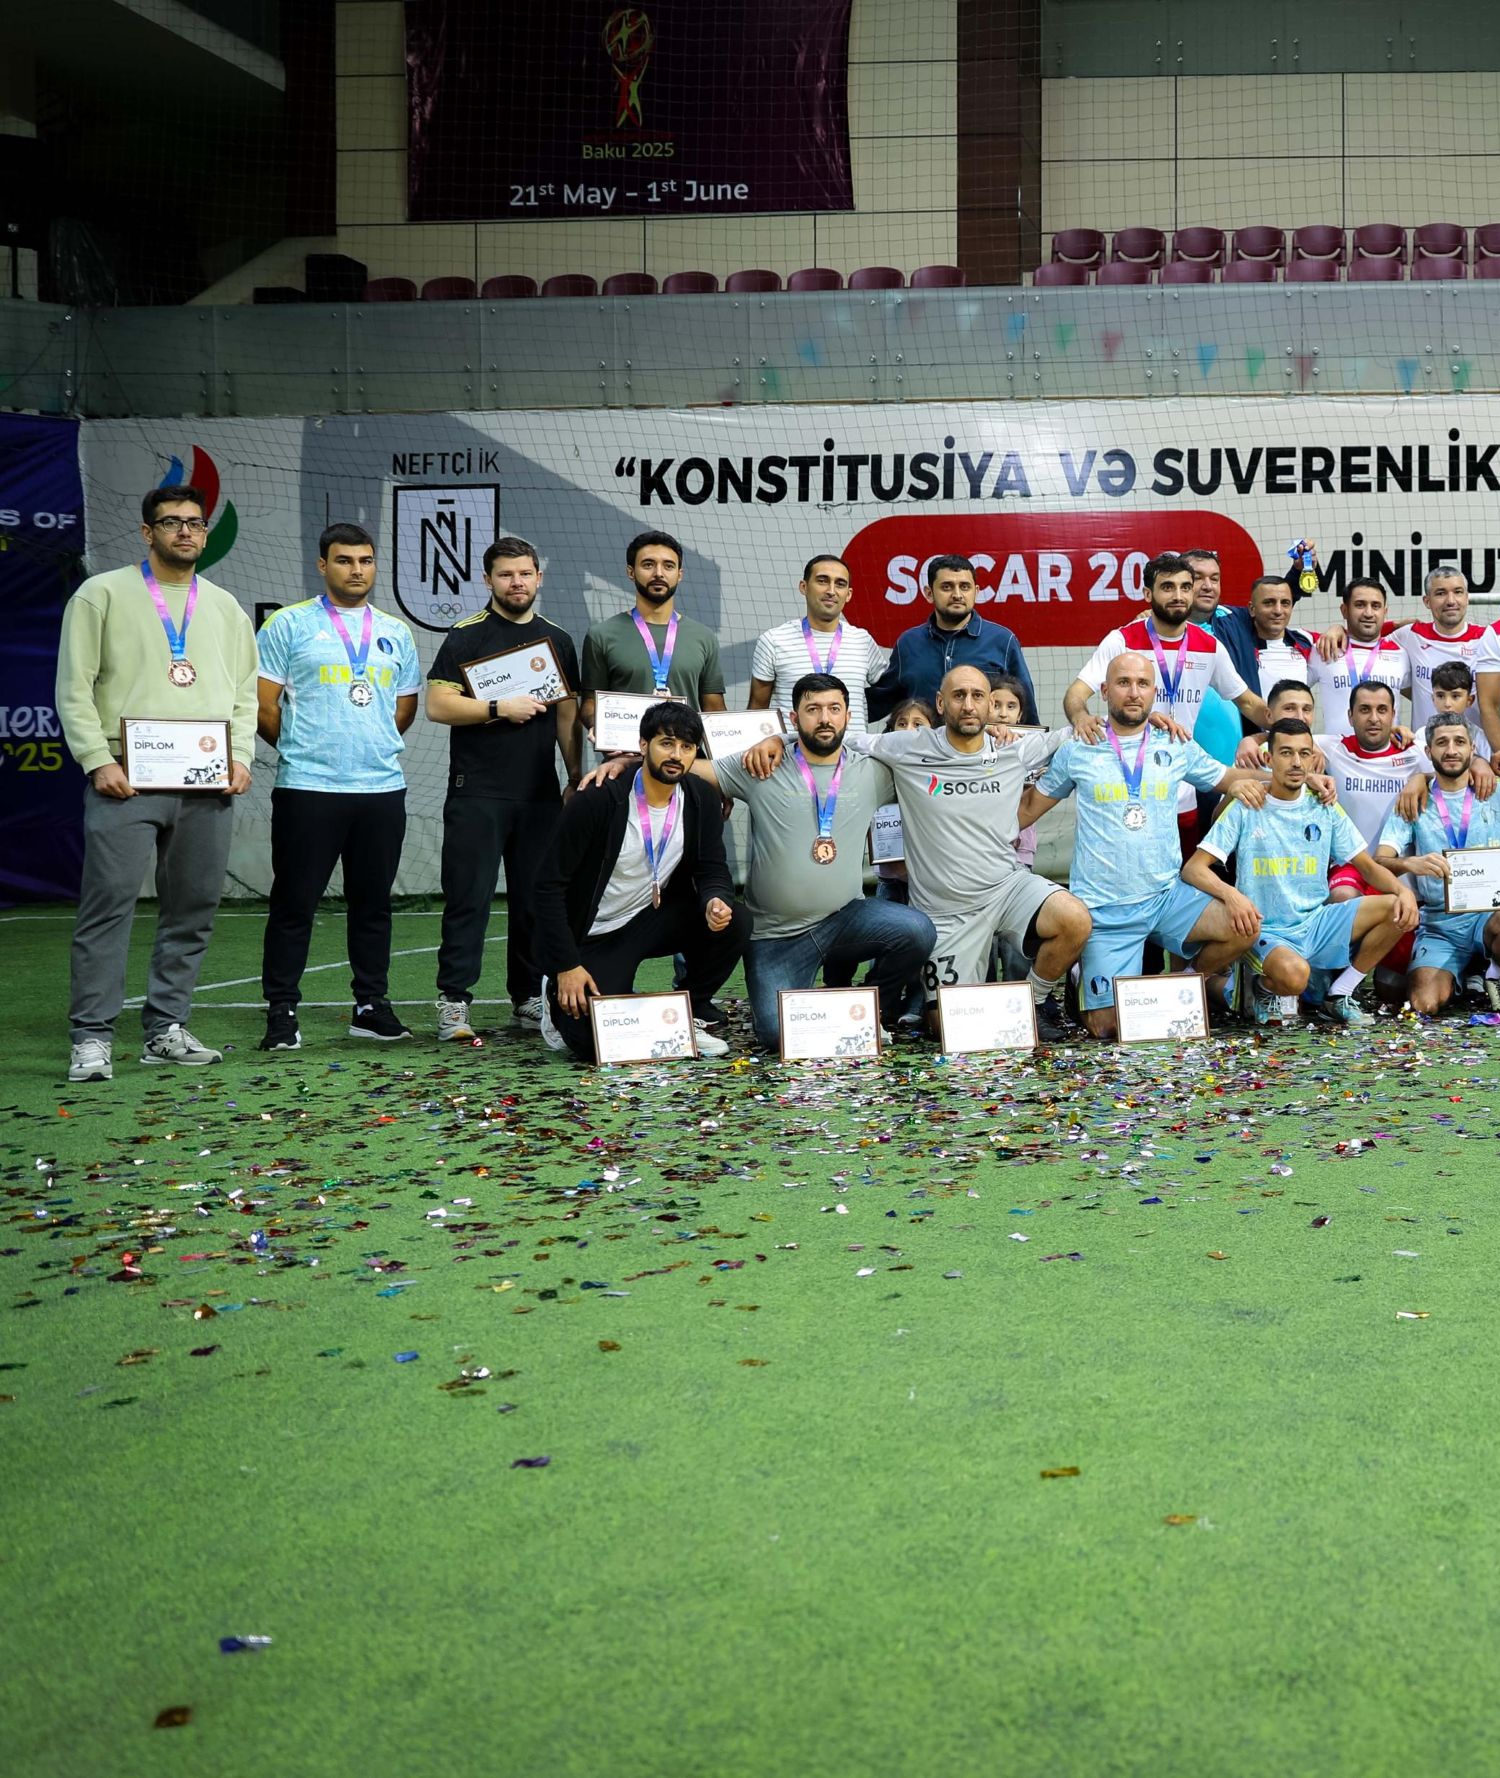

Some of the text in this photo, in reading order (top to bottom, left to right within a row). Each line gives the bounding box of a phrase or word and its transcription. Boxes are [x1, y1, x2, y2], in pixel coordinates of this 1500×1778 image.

[582, 142, 675, 160] Baku 2025
[510, 182, 555, 206] 21st
[563, 183, 617, 209] May
[647, 179, 677, 202] 1st
[683, 180, 749, 202] June
[392, 447, 500, 476] NEFTÇİ İK
[1060, 448, 1136, 497] VƏ
[33, 511, 78, 529] OF
[477, 672, 512, 690] DİPLOM
[604, 710, 638, 720] DİPLOM
[134, 739, 174, 750] DİPLOM
[943, 780, 1000, 796] SOCAR
[1453, 867, 1485, 878] DİPLOM
[924, 954, 959, 991] 83
[1124, 995, 1158, 1006] DİPLOM
[602, 1016, 640, 1028] DİPLOM
[789, 1011, 827, 1022] DİPLOM
